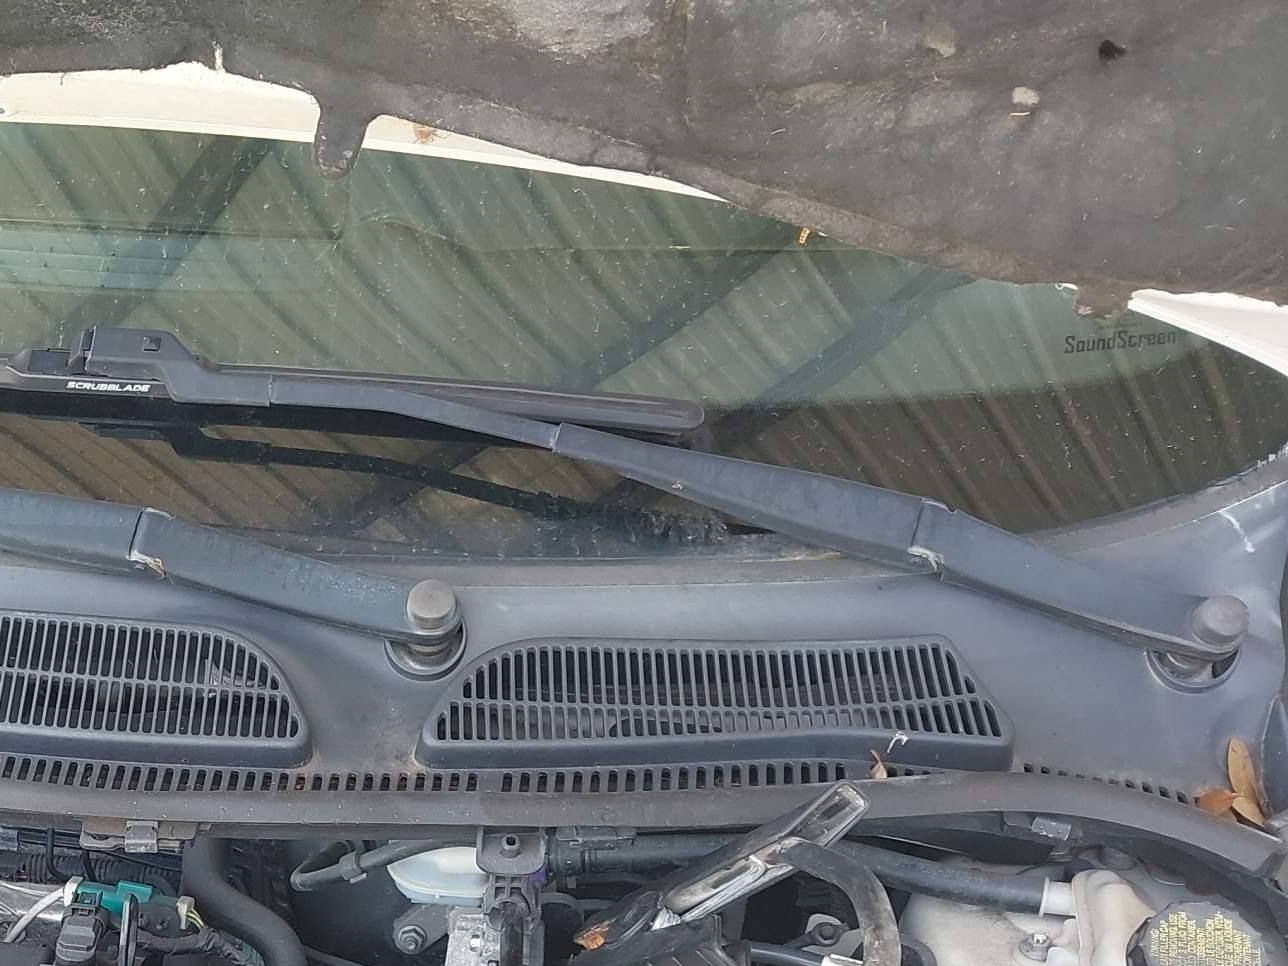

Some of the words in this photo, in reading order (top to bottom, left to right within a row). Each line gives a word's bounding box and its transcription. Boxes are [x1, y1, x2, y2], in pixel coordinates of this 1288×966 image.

[1064, 331, 1176, 353] SoundScreen
[66, 382, 150, 392] SCRUBBLADE
[1160, 920, 1168, 932] CAP
[1177, 912, 1186, 928] FROM
